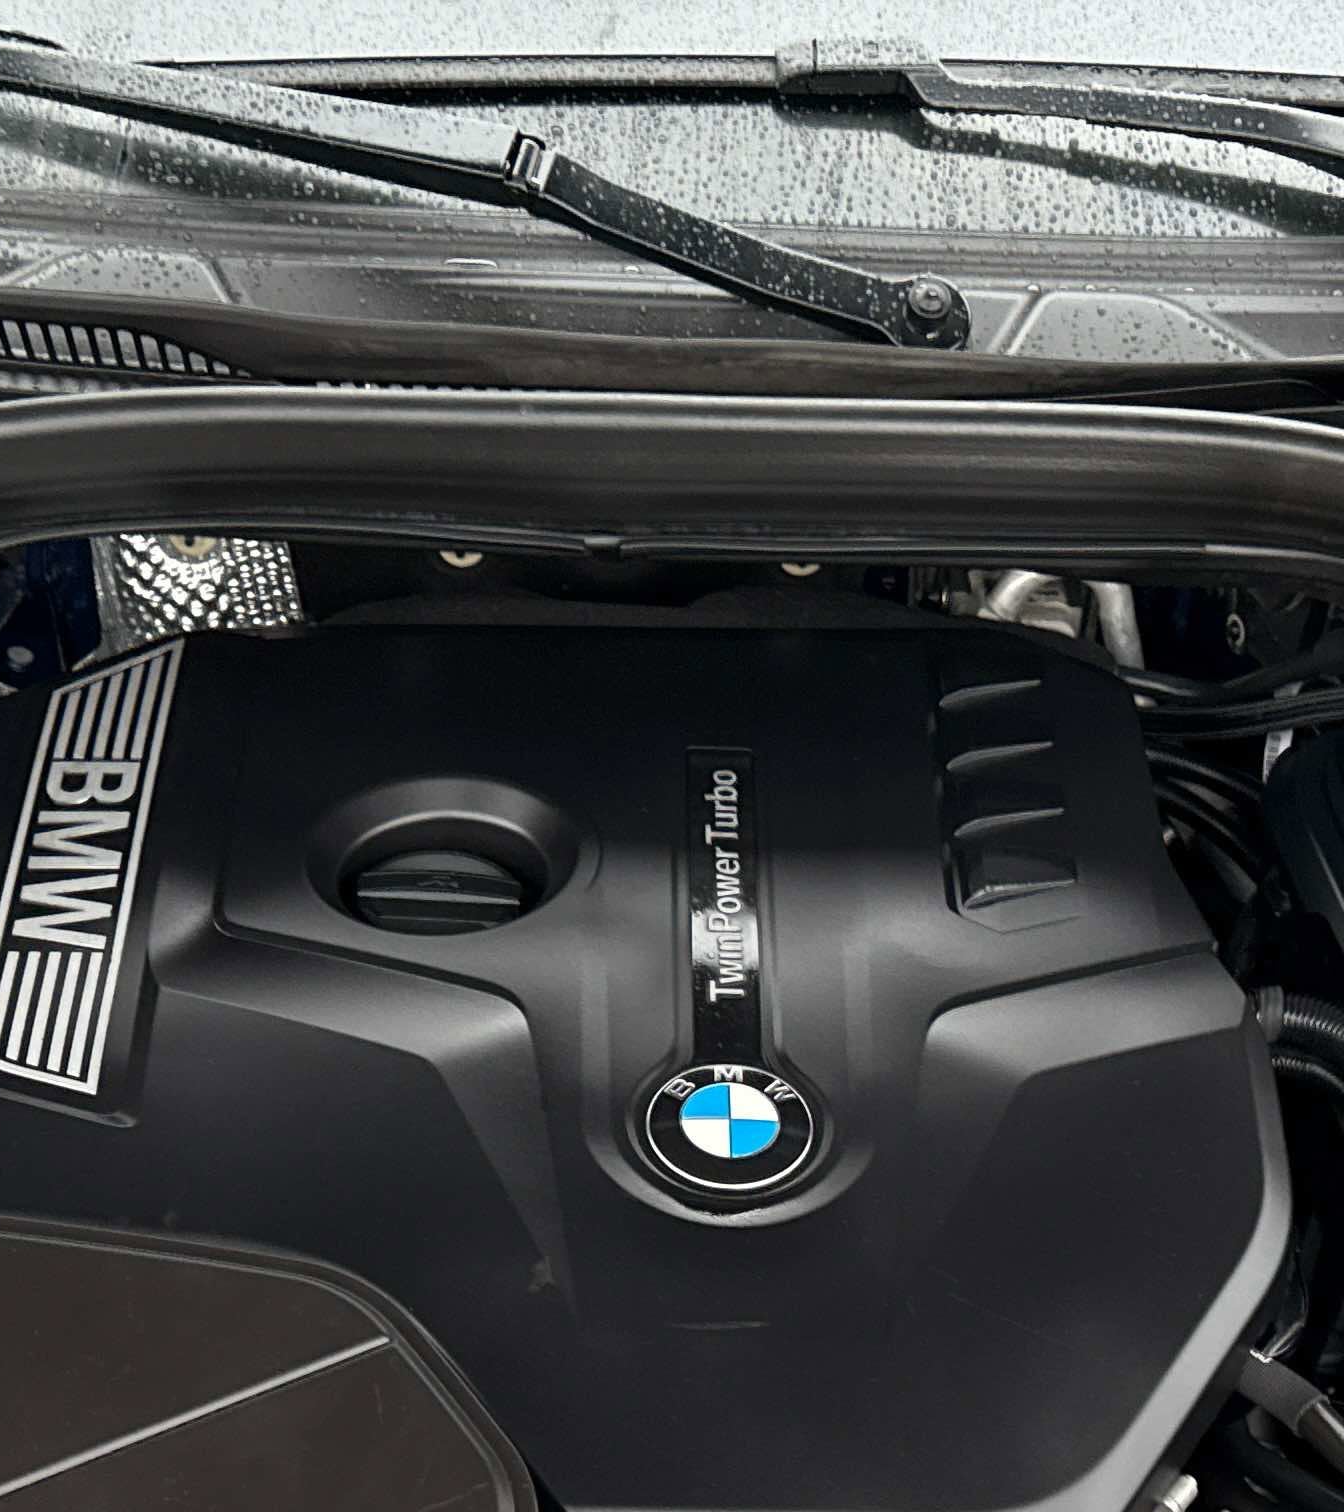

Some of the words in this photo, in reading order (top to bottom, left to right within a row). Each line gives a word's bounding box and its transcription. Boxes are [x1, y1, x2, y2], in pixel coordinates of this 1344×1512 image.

[11, 760, 141, 949] BMW
[704, 768, 740, 846] Turbo
[708, 847, 745, 1002] TwinPower
[664, 1064, 797, 1101] BMW
